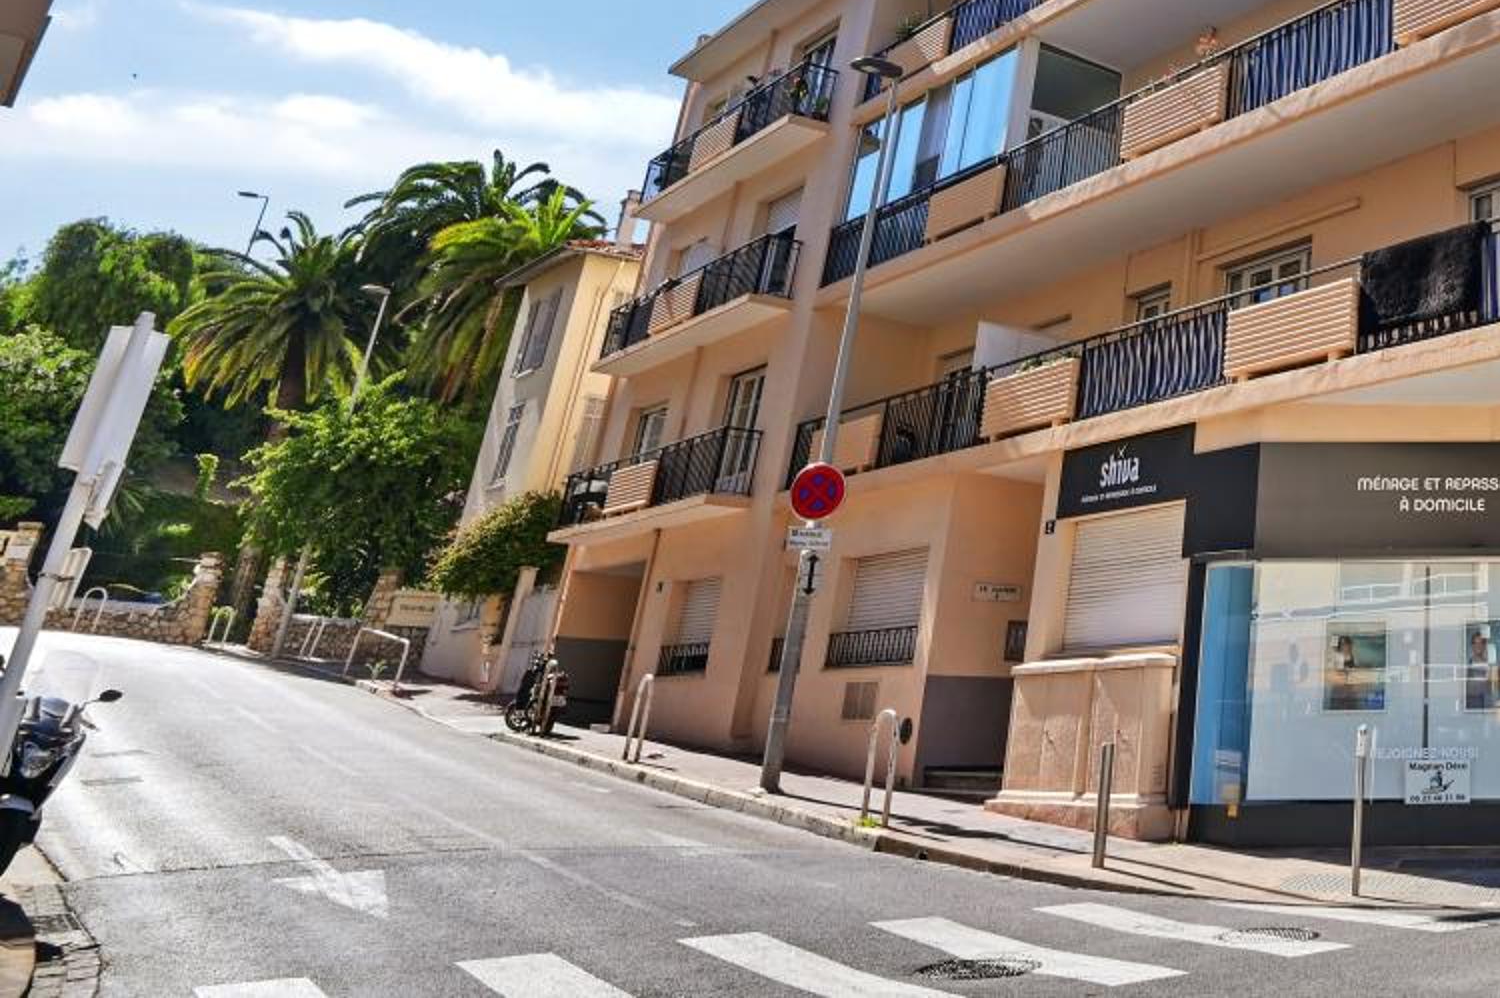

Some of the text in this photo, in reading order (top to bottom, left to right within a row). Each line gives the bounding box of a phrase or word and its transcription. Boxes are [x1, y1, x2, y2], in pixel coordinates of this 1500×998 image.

[1099, 447, 1140, 489] shiva
[1357, 474, 1419, 491] MÉNAGE
[1423, 477, 1441, 491] ET
[1399, 496, 1486, 511] À DOMICILE
